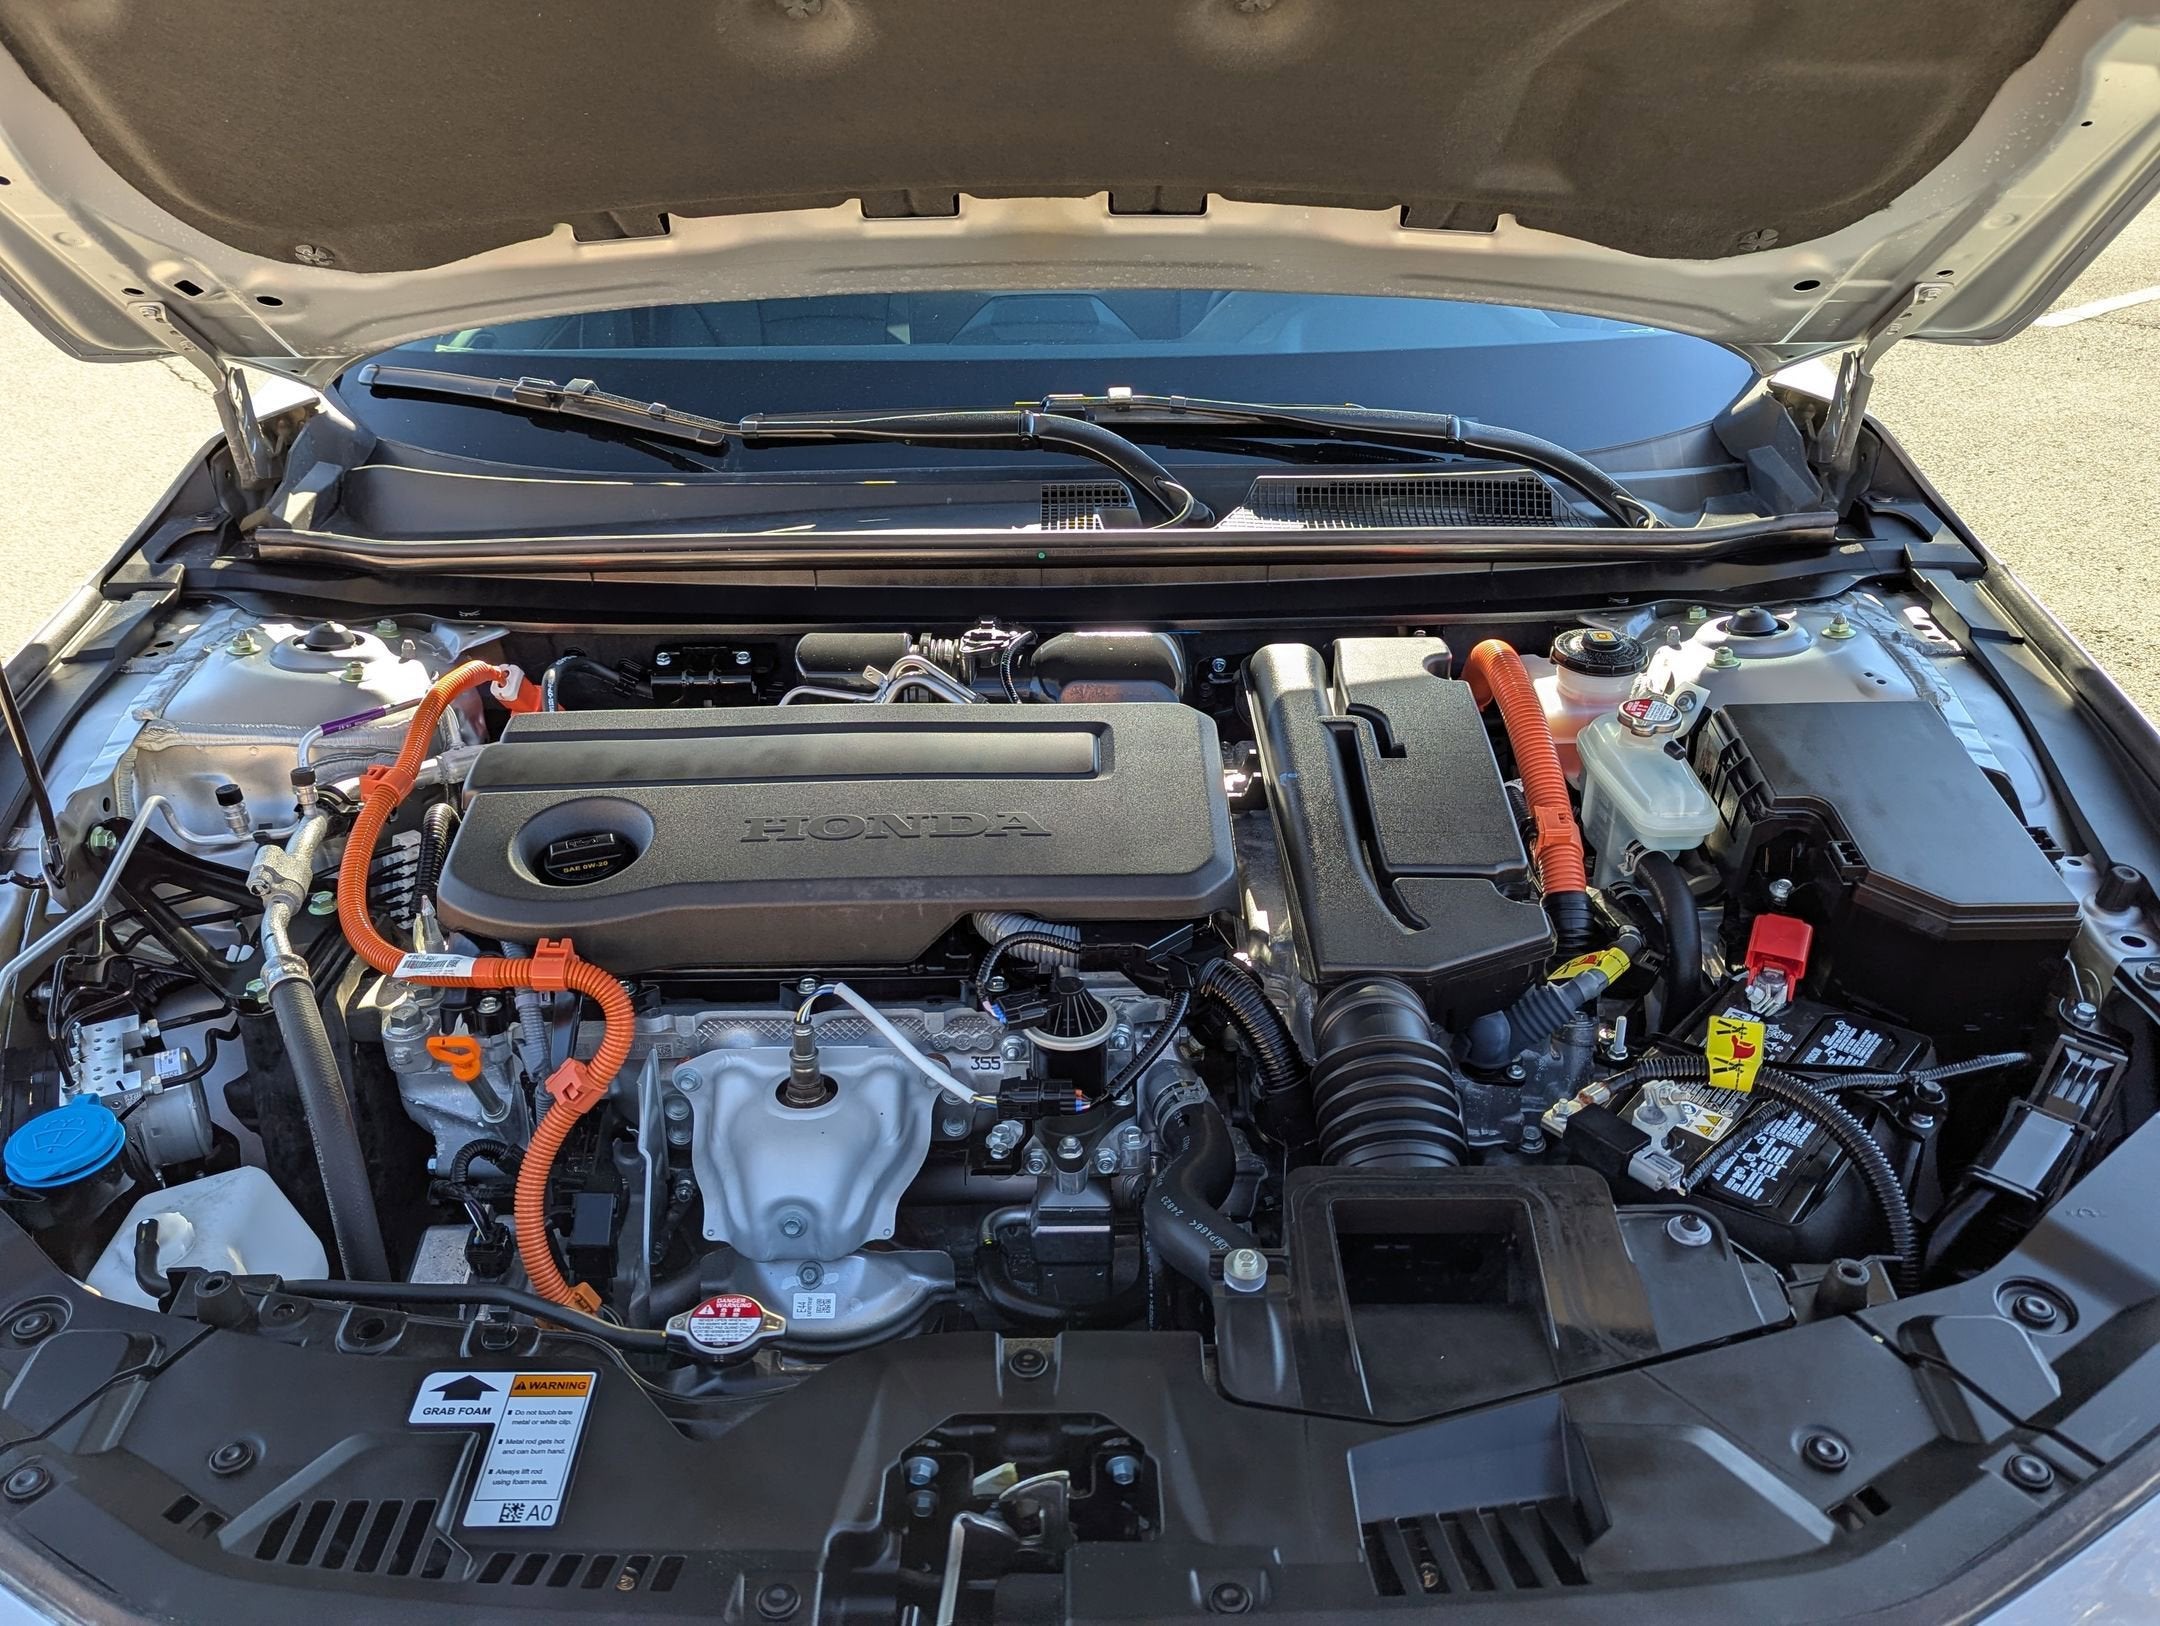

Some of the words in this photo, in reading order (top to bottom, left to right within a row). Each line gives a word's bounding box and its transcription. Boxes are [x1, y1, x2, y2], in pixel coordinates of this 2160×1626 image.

[740, 811, 1052, 842] HONDA
[583, 860, 609, 870] 0W-20
[970, 1055, 1001, 1070] 355
[529, 1381, 587, 1390] WARNING
[422, 1407, 456, 1416] GRAB
[457, 1407, 492, 1416] FOAM
[495, 1468, 520, 1476] Always
[525, 1504, 553, 1521] A0
